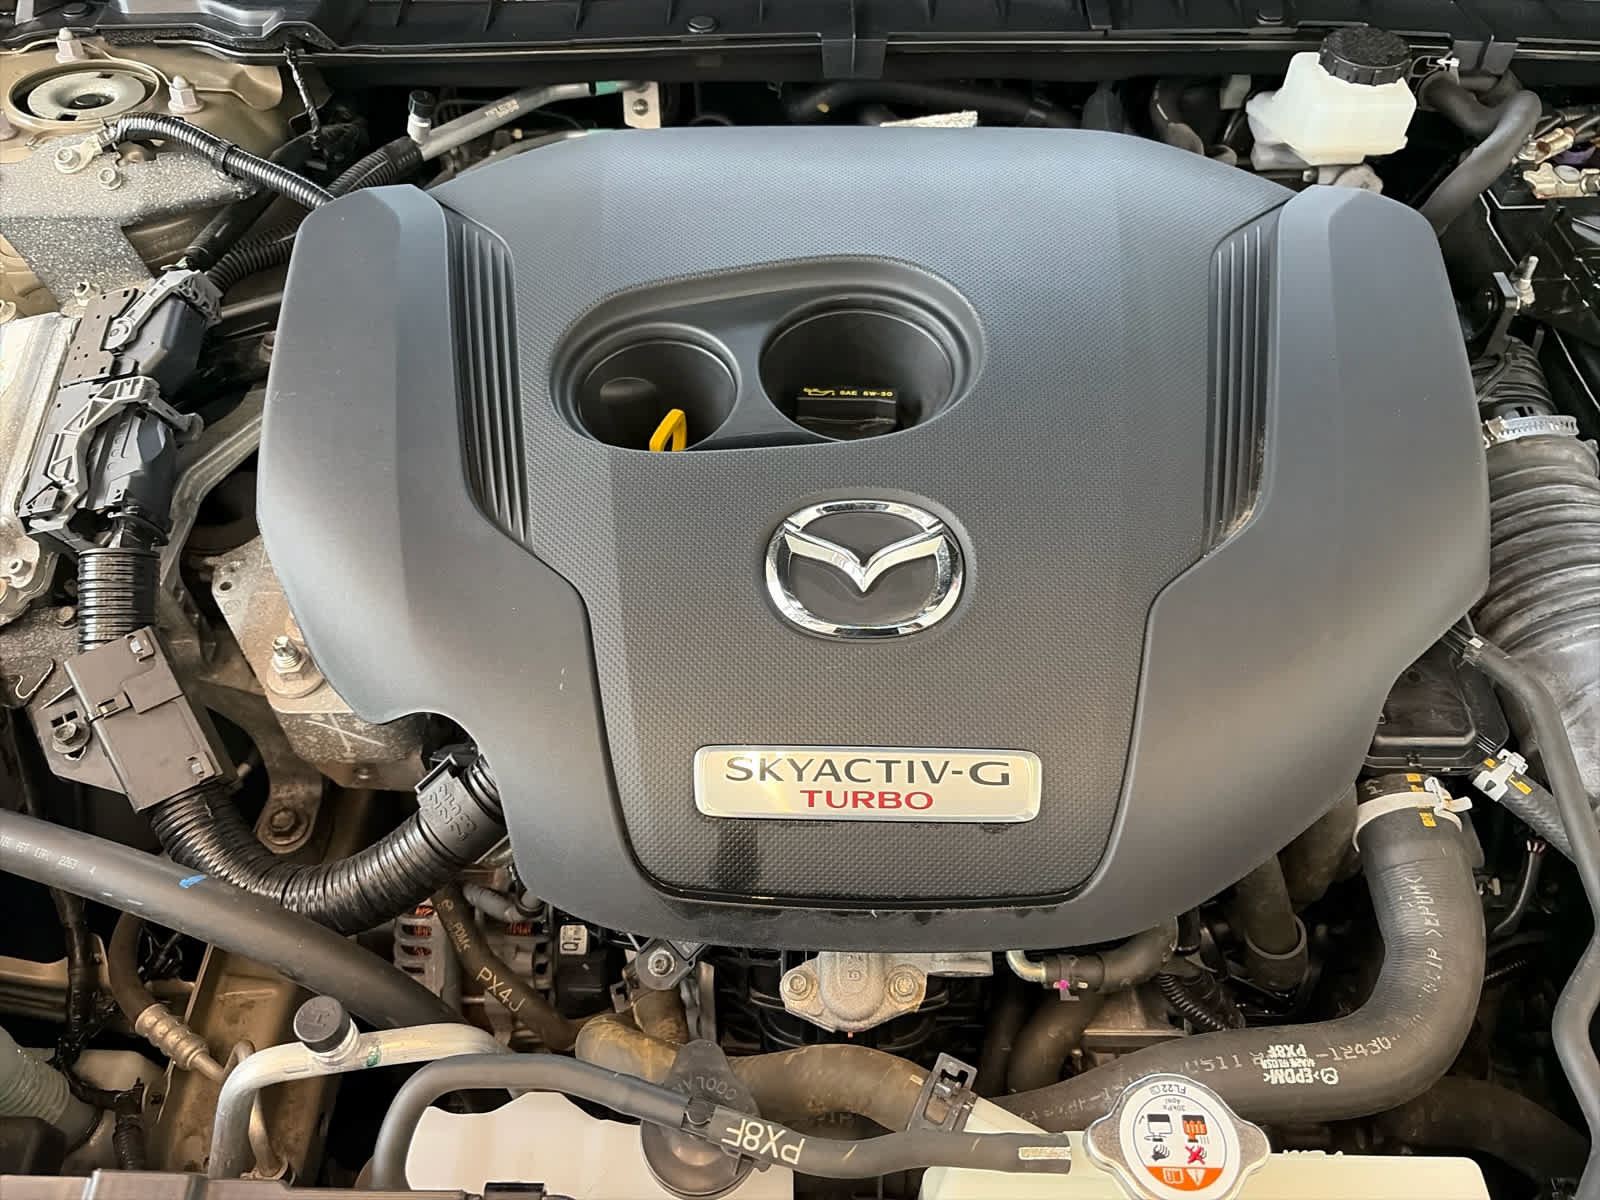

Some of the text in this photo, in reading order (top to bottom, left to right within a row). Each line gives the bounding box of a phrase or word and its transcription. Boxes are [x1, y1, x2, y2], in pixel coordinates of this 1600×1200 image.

[862, 390, 894, 398] 5W-30
[725, 757, 1011, 786] SKYACTIV-G
[800, 790, 934, 810] TURBO
[475, 966, 526, 1013] PX4J
[721, 1118, 806, 1165] PX8F
